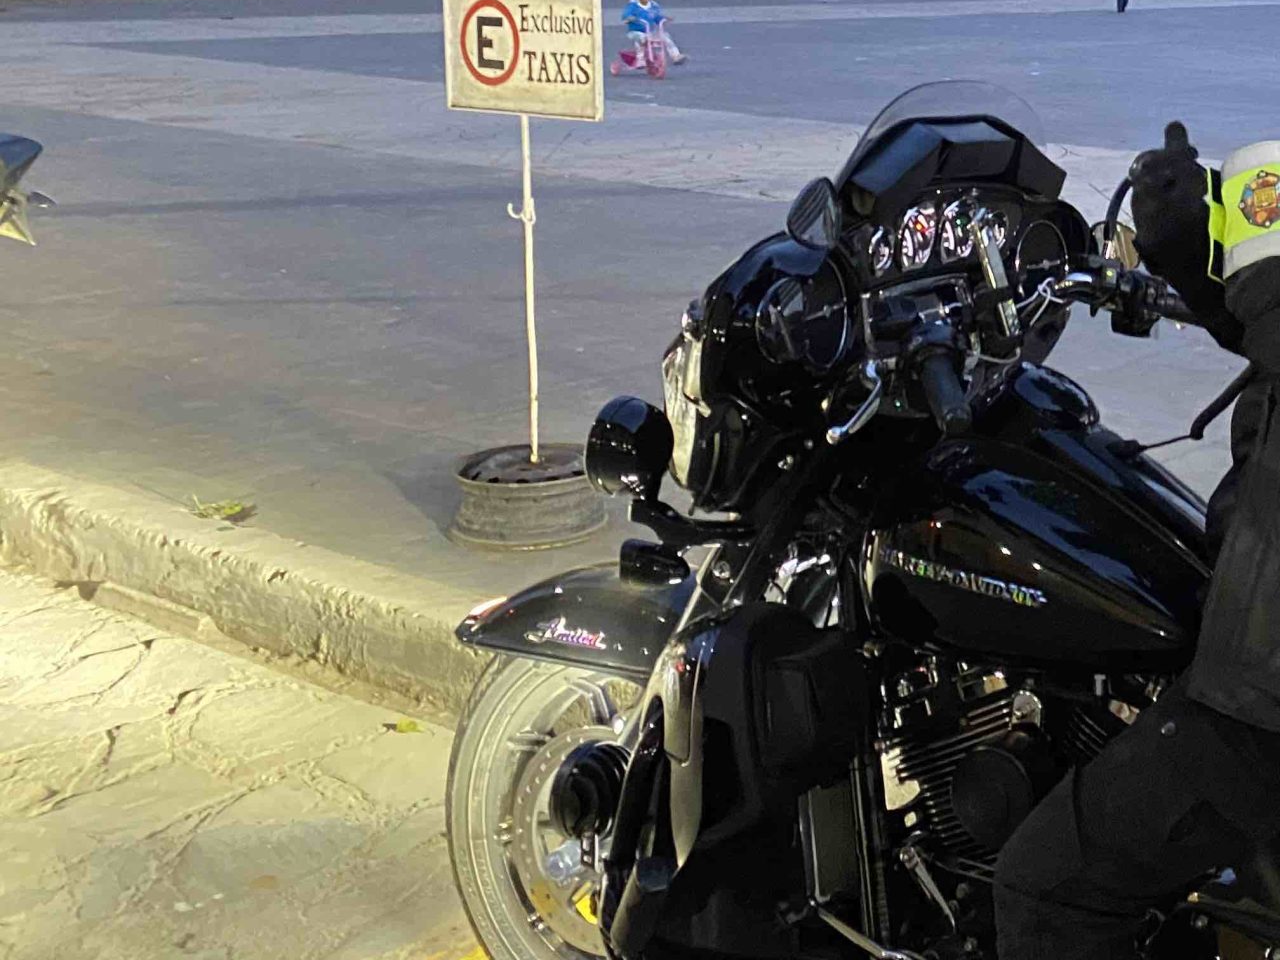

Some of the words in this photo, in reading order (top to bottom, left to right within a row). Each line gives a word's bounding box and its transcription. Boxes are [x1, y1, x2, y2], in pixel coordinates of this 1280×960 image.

[518, 4, 593, 35] Exclusivo
[477, 16, 505, 70] E
[523, 51, 591, 85] TAXIS
